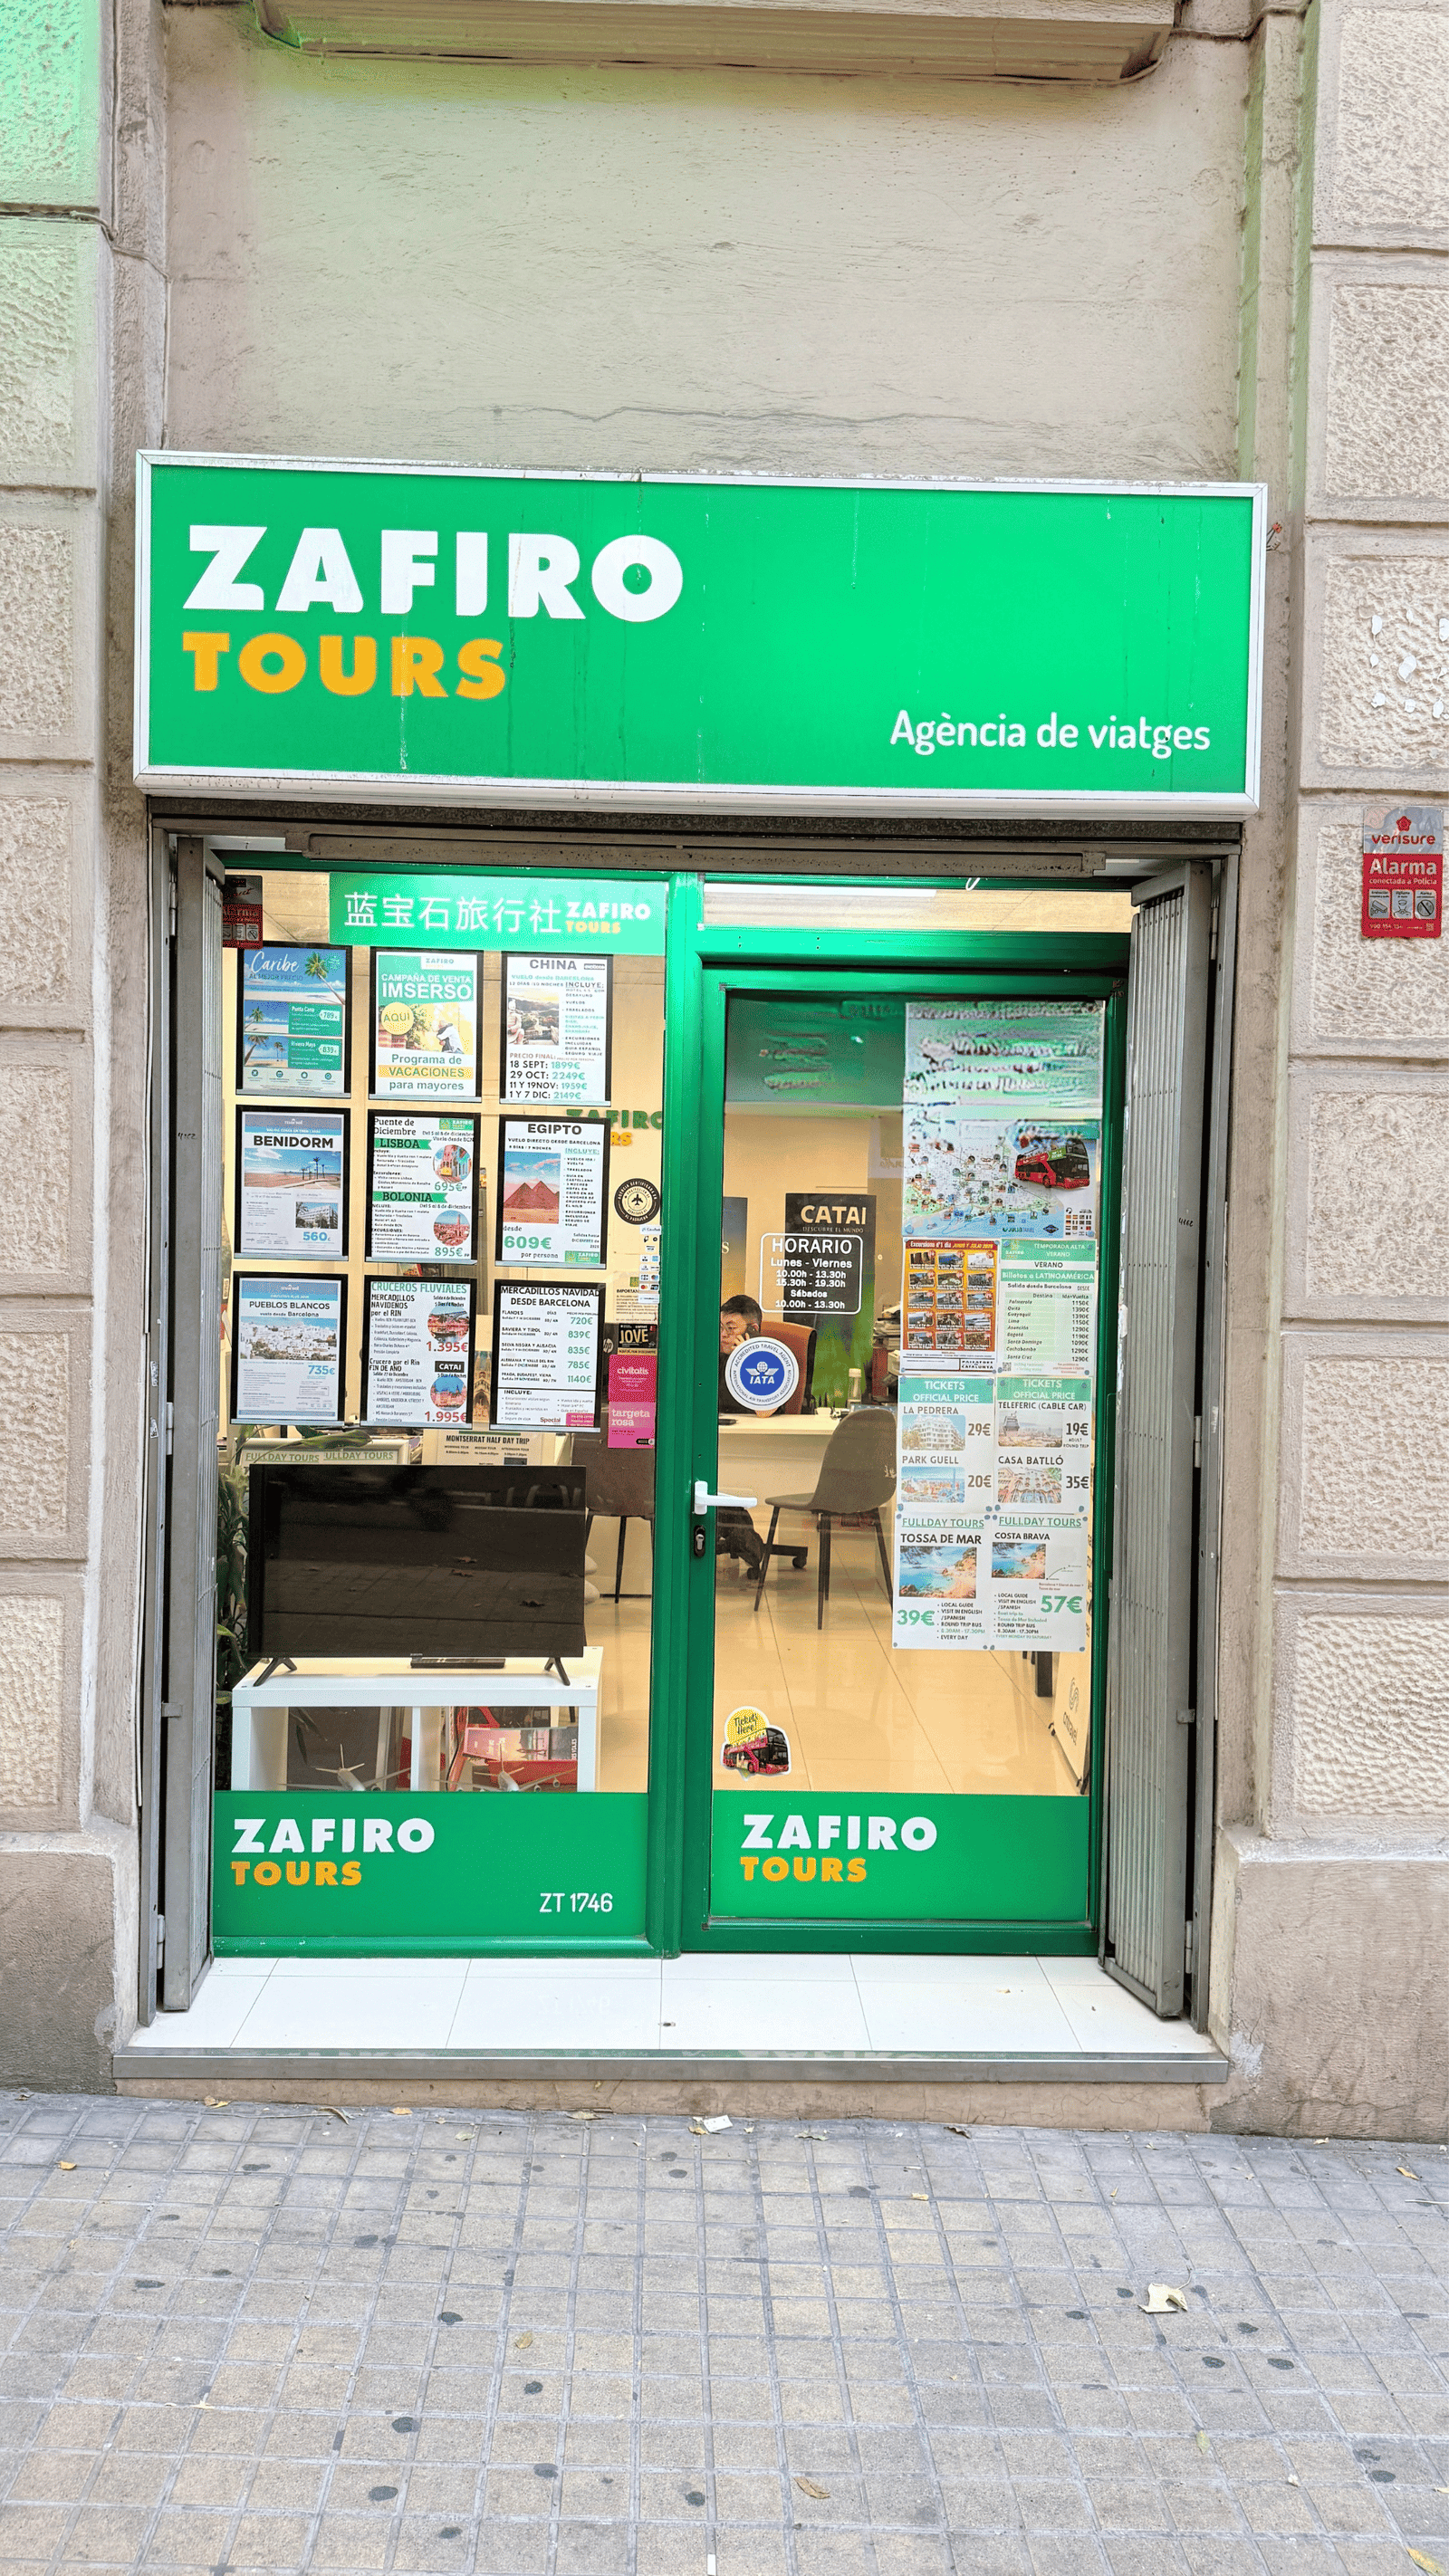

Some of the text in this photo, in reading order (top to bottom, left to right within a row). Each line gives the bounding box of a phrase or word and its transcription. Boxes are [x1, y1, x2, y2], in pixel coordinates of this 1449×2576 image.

[182, 524, 684, 623] ZAFIRO
[182, 631, 506, 701] TOURS
[890, 710, 1211, 759] Agència de viatges
[1371, 835, 1435, 845] verisure
[1369, 857, 1437, 875] Alarma
[344, 892, 561, 934] 蓝宝石旅行社
[566, 902, 650, 920] ZAFIRO
[566, 921, 620, 934] TOURS
[251, 951, 300, 973] Caribe
[530, 959, 577, 971] CHINA
[381, 973, 472, 984] CAMPAÑA DE VENTA
[382, 982, 472, 1000] IMSERSO
[391, 1054, 462, 1066] Programa de
[510, 1060, 581, 1069] 18 SEPT: 1899€
[389, 1067, 465, 1077] VACACIONES
[510, 1070, 585, 1080] 29 OCT: 2249€
[389, 1082, 465, 1092] para mayores
[533, 1091, 551, 1099] DIC:
[374, 1118, 415, 1126] Puente de
[374, 1127, 417, 1135] Diciembre
[528, 1124, 582, 1135] EGIPTO
[254, 1135, 333, 1149] BENIDORM
[380, 1138, 420, 1149] LISBOA
[435, 1182, 463, 1192] 695€
[382, 1192, 433, 1202] BOLONIA
[801, 1205, 867, 1224] CATAI
[504, 1236, 552, 1250] 609€
[772, 1238, 852, 1254] HORARIO
[435, 1247, 463, 1257] 895€
[771, 1257, 852, 1269] Lunes Viernes
[776, 1269, 846, 1278] 10.00h 13.30h
[1035, 1271, 1094, 1279] LATINOAMÉRICA
[371, 1282, 467, 1294] CRUCEROS FLUVIALES
[776, 1278, 846, 1288] 15.30h 19.30h
[501, 1287, 561, 1296] MERCADILLOS
[791, 1289, 828, 1298] Sábados
[371, 1294, 416, 1302] MERCADILLOS
[511, 1298, 590, 1307] DESDE BARCELONA
[249, 1301, 331, 1310] PUEBLOS BLANCOS
[775, 1300, 845, 1309] 10.00h 13.30h
[571, 1317, 593, 1325] 720€
[568, 1330, 590, 1339] 839€
[619, 1328, 648, 1344] JOVE
[426, 1341, 468, 1352] 1.395€
[568, 1346, 590, 1355] 835€
[734, 1344, 791, 1367] ACCREDITED TRAVEL AGENT
[308, 1365, 335, 1375] 735€
[568, 1361, 590, 1369] 785€
[568, 1375, 591, 1384] 1140€
[749, 1376, 775, 1384] IATA
[1022, 1379, 1062, 1388] TICKETS
[925, 1381, 964, 1390] TICKETS
[913, 1393, 979, 1403] OFFICIAL PRICE
[1013, 1391, 1076, 1400] OFFICIAL PRICE
[917, 1406, 959, 1414] PEDRERA
[1038, 1403, 1066, 1411] (CABLE
[425, 1412, 466, 1422] 1.995€
[611, 1409, 650, 1420] targeta
[967, 1423, 991, 1436] 29€
[1066, 1422, 1089, 1436] 19€
[446, 1435, 485, 1443] MONTSERRAT
[245, 1452, 320, 1462] FULLDAY TOURS
[325, 1451, 393, 1460] ULLDAY TOURS
[902, 1455, 959, 1464] PARK GUELL
[998, 1454, 1064, 1465] CASA BATLLÓ
[967, 1475, 992, 1488] 20€
[1066, 1475, 1089, 1489] 35€
[902, 1518, 984, 1528] FULLDAY TOURS
[999, 1517, 1082, 1527] FULLDAY TOURS
[901, 1533, 982, 1545] TOSSA DE MAR
[994, 1532, 1022, 1540] COSTA
[1041, 1595, 1082, 1614] 57€
[897, 1609, 935, 1626] 39€
[231, 1817, 435, 1853] ZAFIRO
[741, 1814, 937, 1852] ZAFIRO
[231, 1862, 362, 1886] TOURS
[740, 1856, 867, 1882] TOURS
[539, 1892, 613, 1912] ZT 1746
